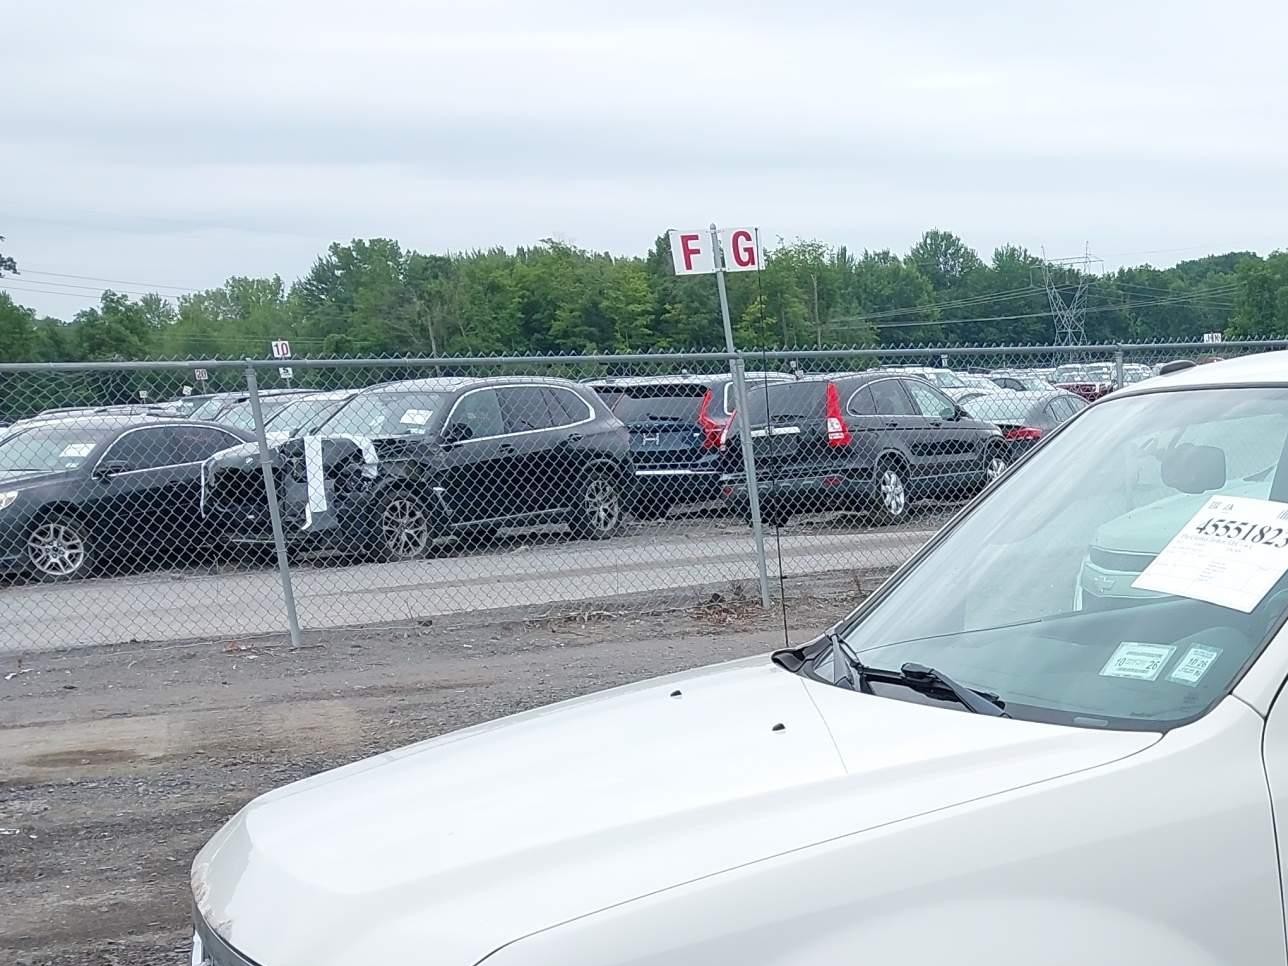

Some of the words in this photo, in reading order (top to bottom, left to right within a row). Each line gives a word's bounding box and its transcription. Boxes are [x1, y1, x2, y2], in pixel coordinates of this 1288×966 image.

[681, 234, 701, 271] F
[732, 230, 756, 267] G
[274, 342, 289, 356] 10
